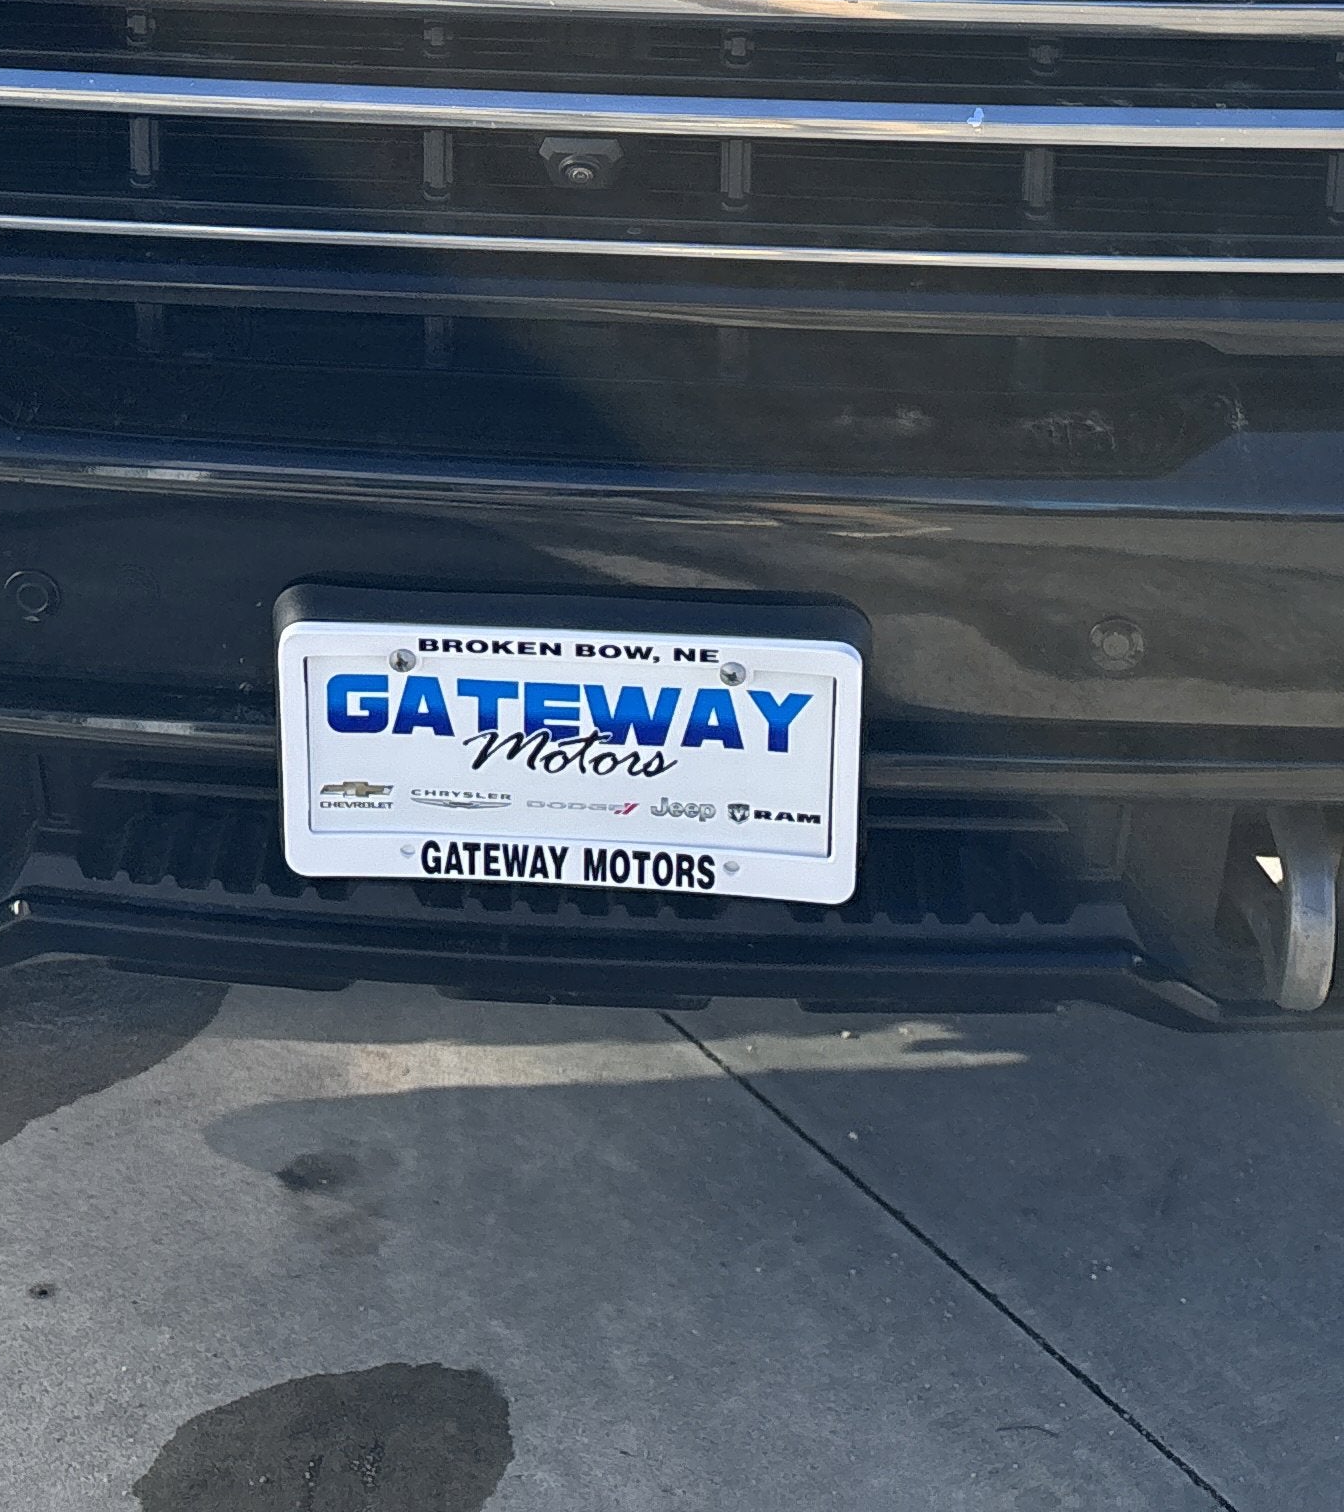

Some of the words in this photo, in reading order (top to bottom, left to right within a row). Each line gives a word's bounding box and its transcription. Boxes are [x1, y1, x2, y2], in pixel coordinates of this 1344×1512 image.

[417, 637, 563, 657] BROKEN
[574, 642, 661, 664] BOW,
[673, 647, 721, 664] NE
[326, 673, 815, 754] GATEWAY
[462, 728, 678, 778] Motors
[319, 800, 394, 810] CHEVROLET
[410, 788, 513, 801] CHRYSLER
[526, 799, 624, 812] DODGE
[650, 796, 717, 822] Jeep
[753, 808, 822, 825] RAM
[420, 839, 570, 879] GATEWAY
[583, 847, 716, 890] MOTORS
